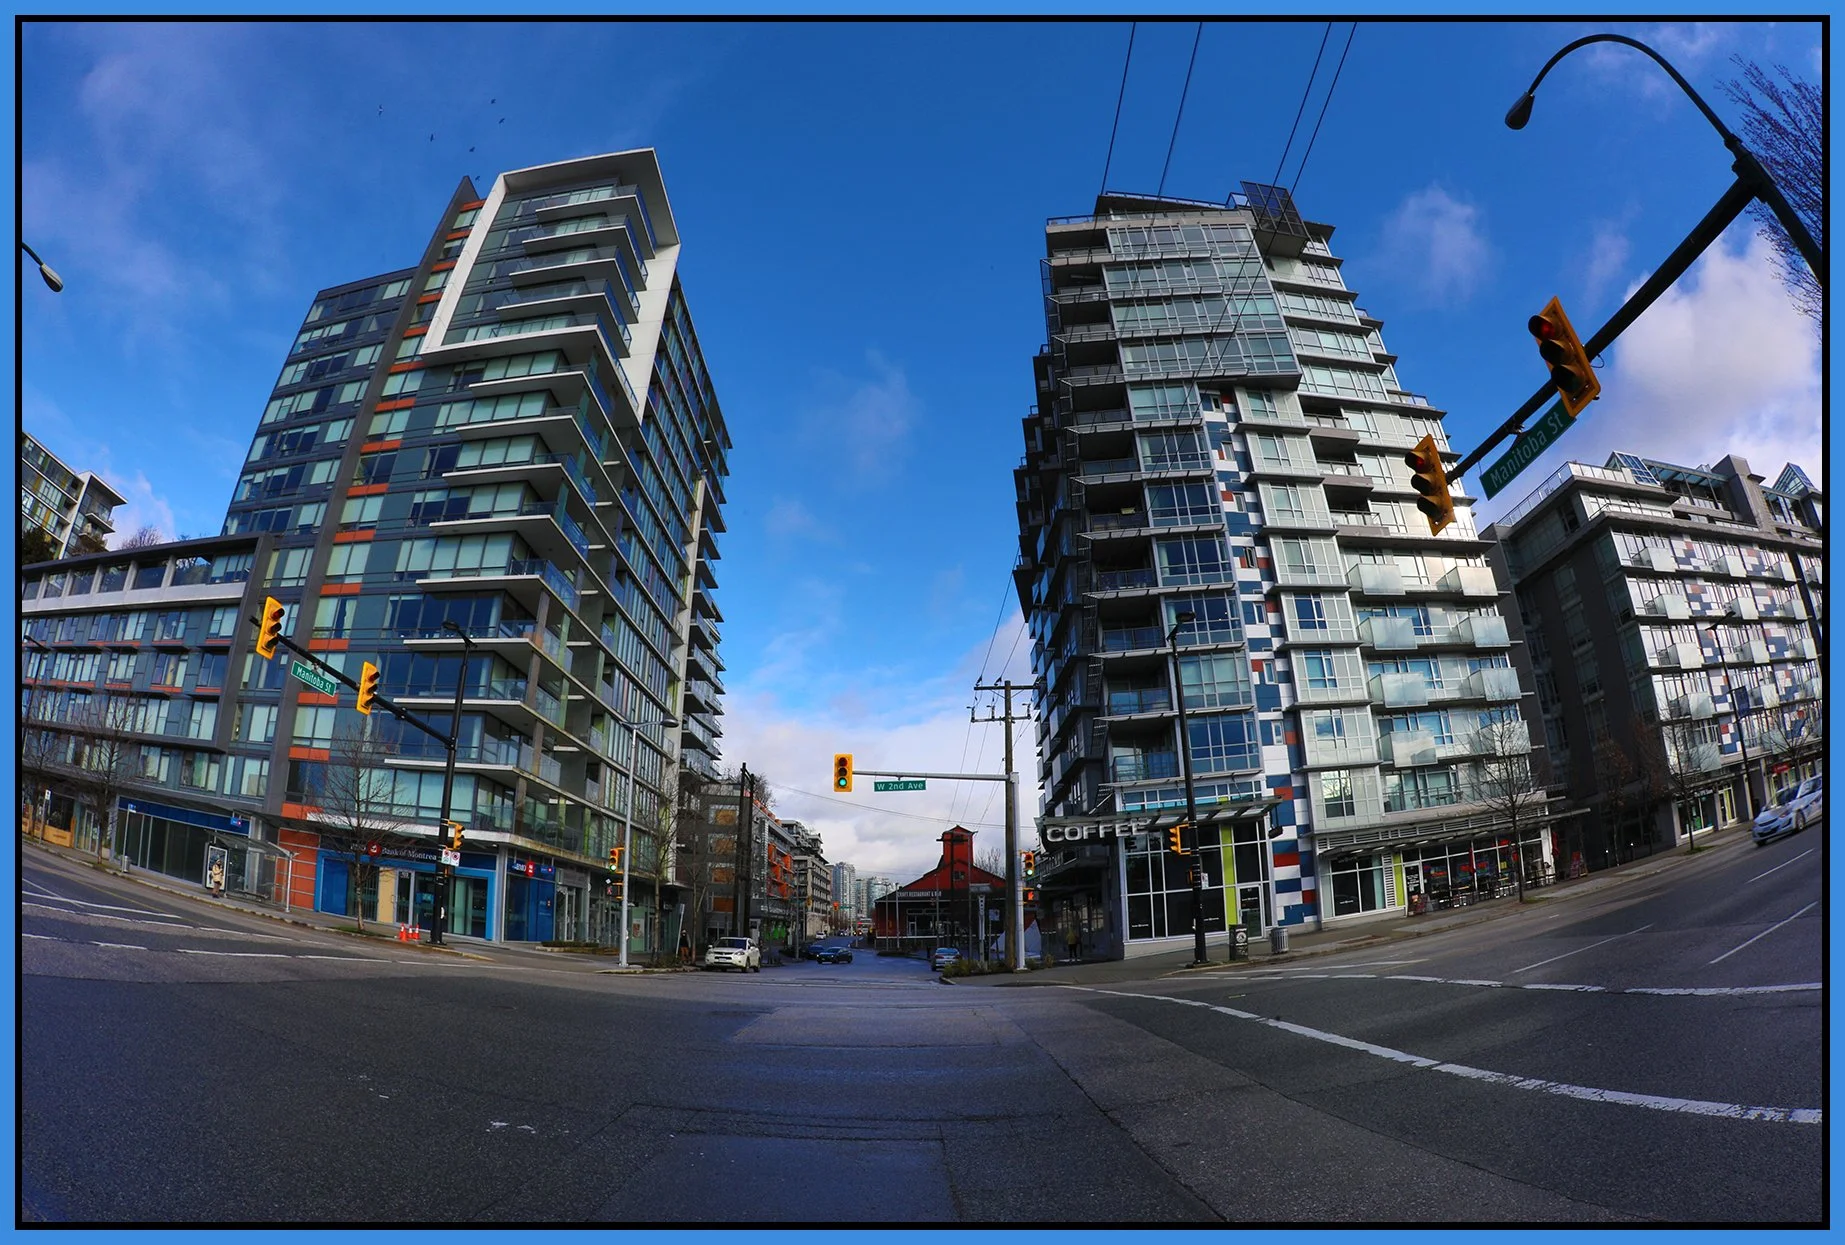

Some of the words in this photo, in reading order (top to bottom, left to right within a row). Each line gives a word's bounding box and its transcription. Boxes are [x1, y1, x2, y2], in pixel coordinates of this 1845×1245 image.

[1489, 429, 1548, 489] Manitoba
[1548, 410, 1564, 435] St
[296, 666, 324, 689] Manitoba
[325, 682, 332, 693] St
[889, 782, 904, 790] 2nd
[907, 782, 924, 790] Ave
[1046, 818, 1151, 842] COFFEE
[382, 847, 399, 856] Bank
[399, 848, 407, 857] of
[408, 849, 437, 861] Montrea
